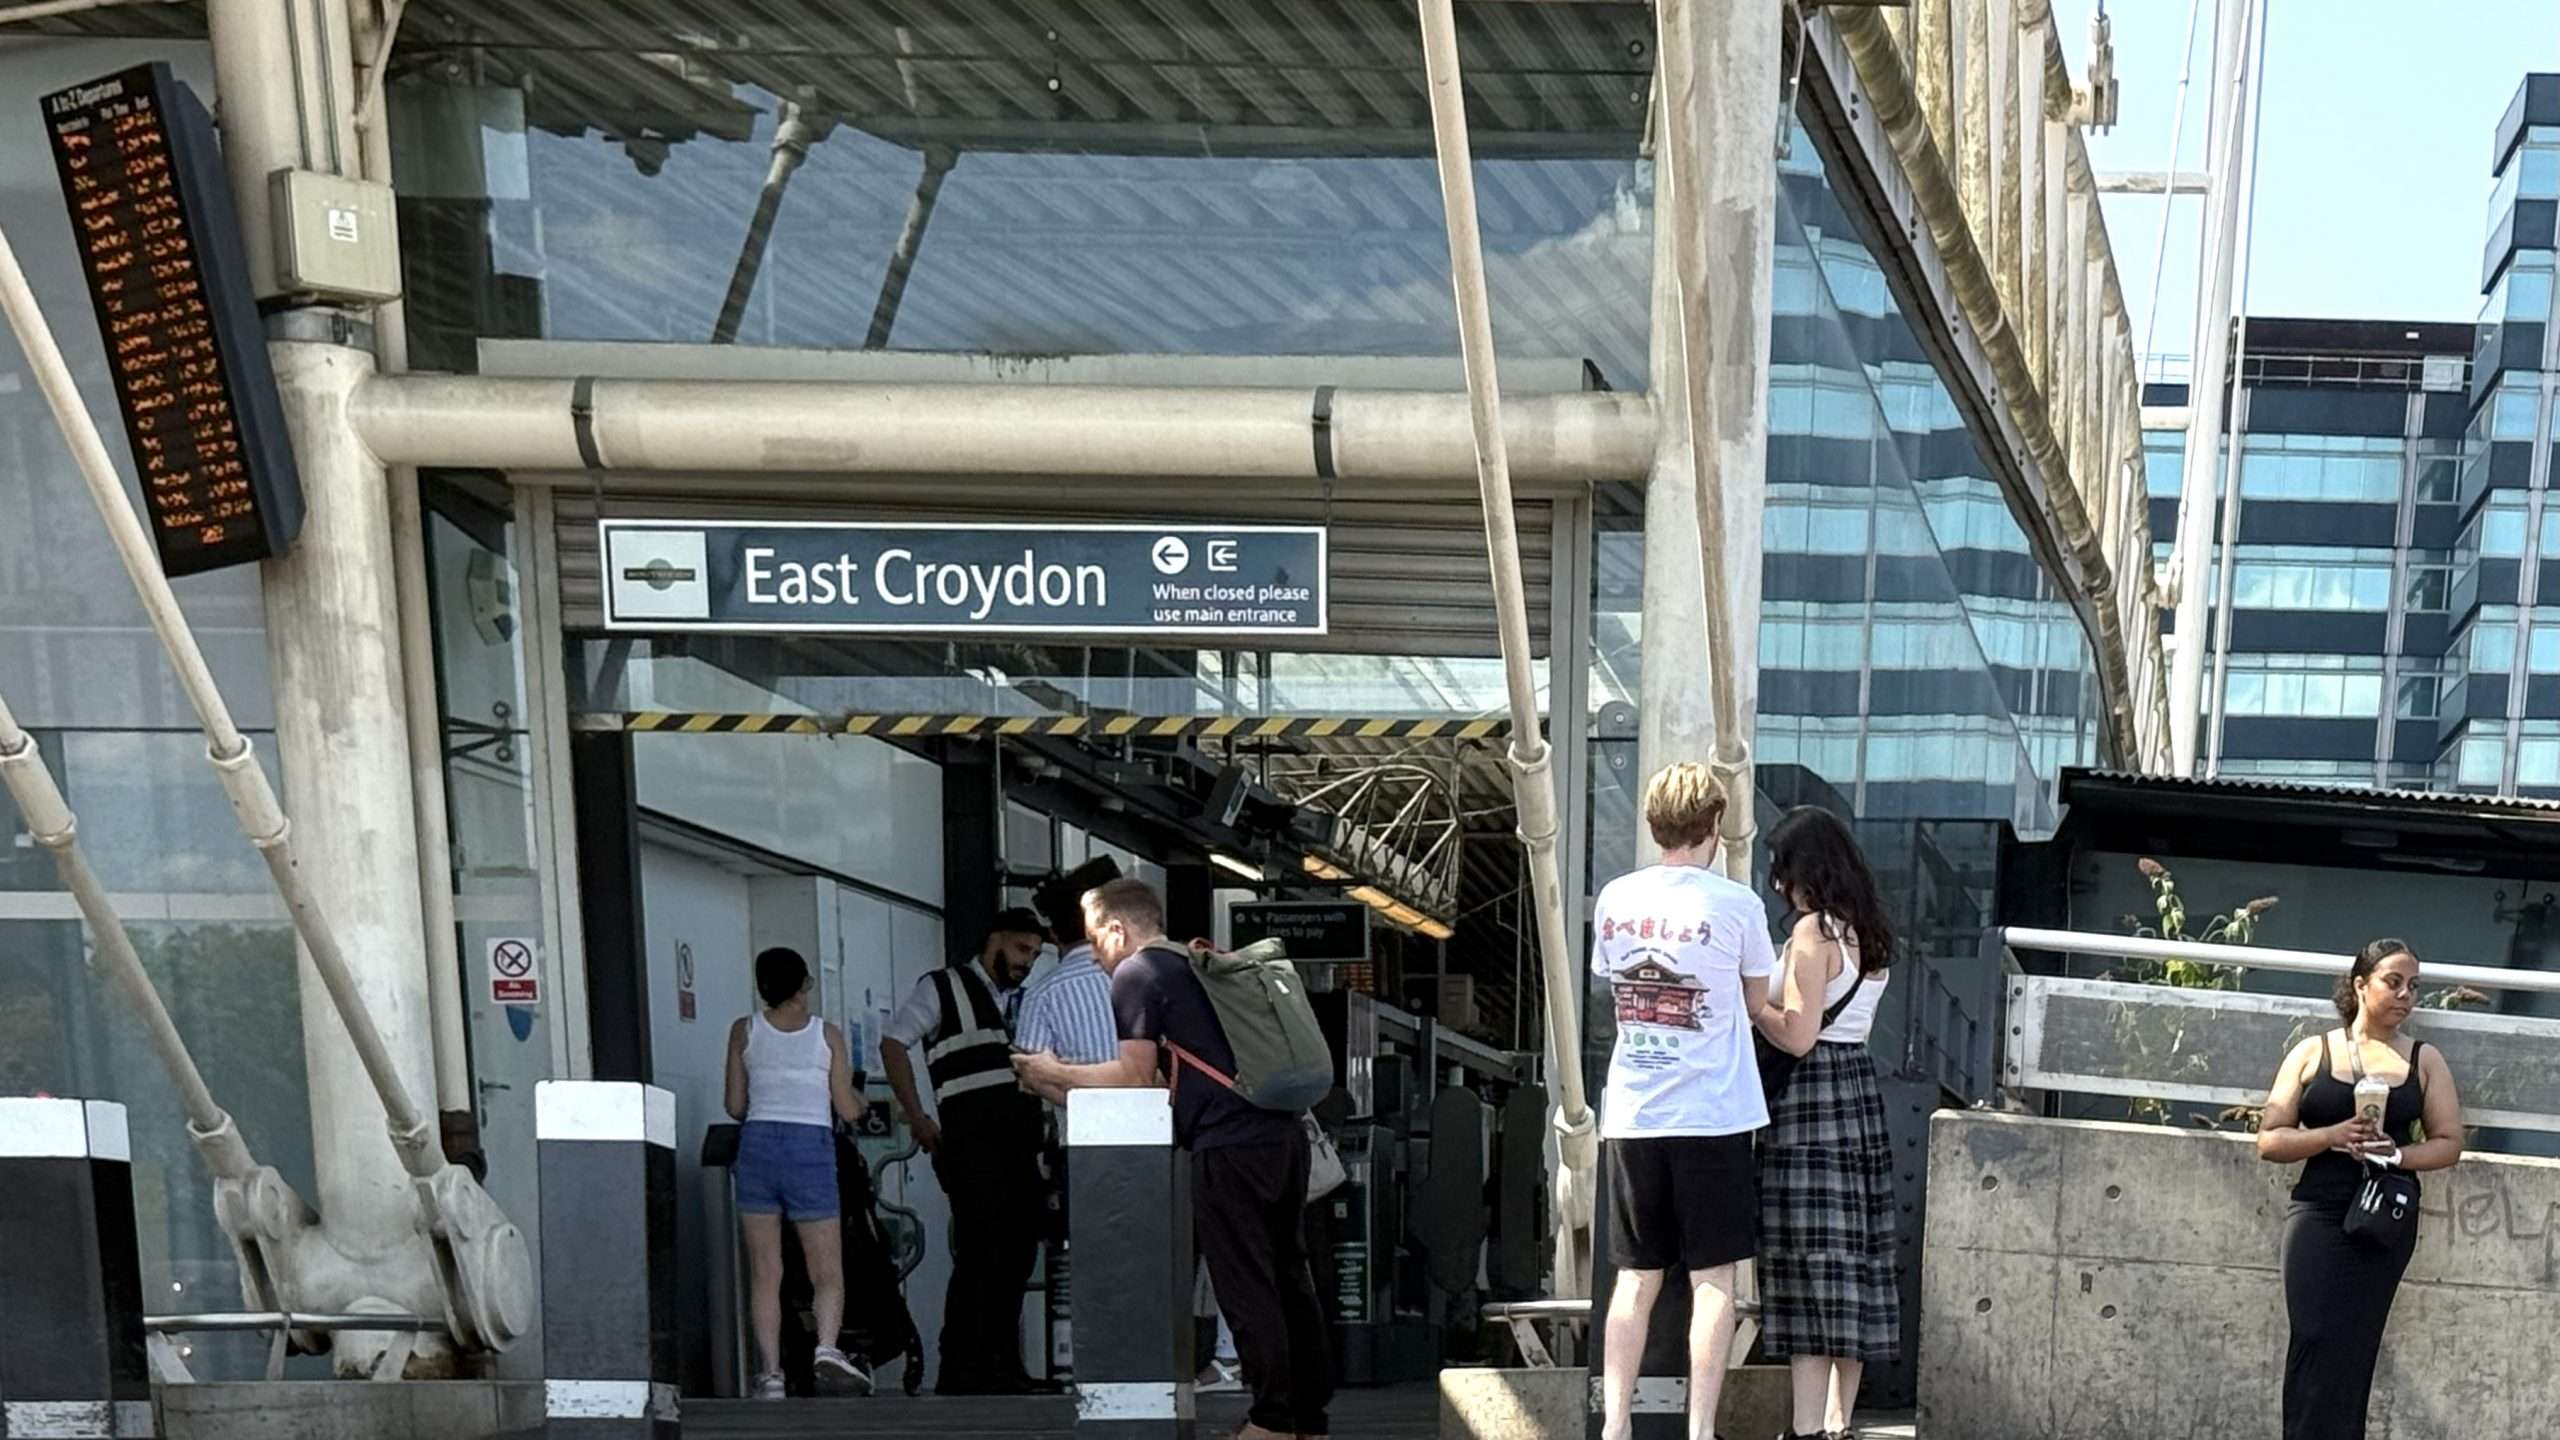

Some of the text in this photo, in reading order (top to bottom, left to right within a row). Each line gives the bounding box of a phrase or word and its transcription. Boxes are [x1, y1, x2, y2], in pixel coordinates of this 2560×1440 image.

[744, 547, 1107, 620] East Croydon
[1152, 583, 1310, 604] When closed please
[1153, 606, 1297, 622] use main entrance
[1266, 911, 1346, 925] Passengers with
[1265, 927, 1325, 939] fares to pay
